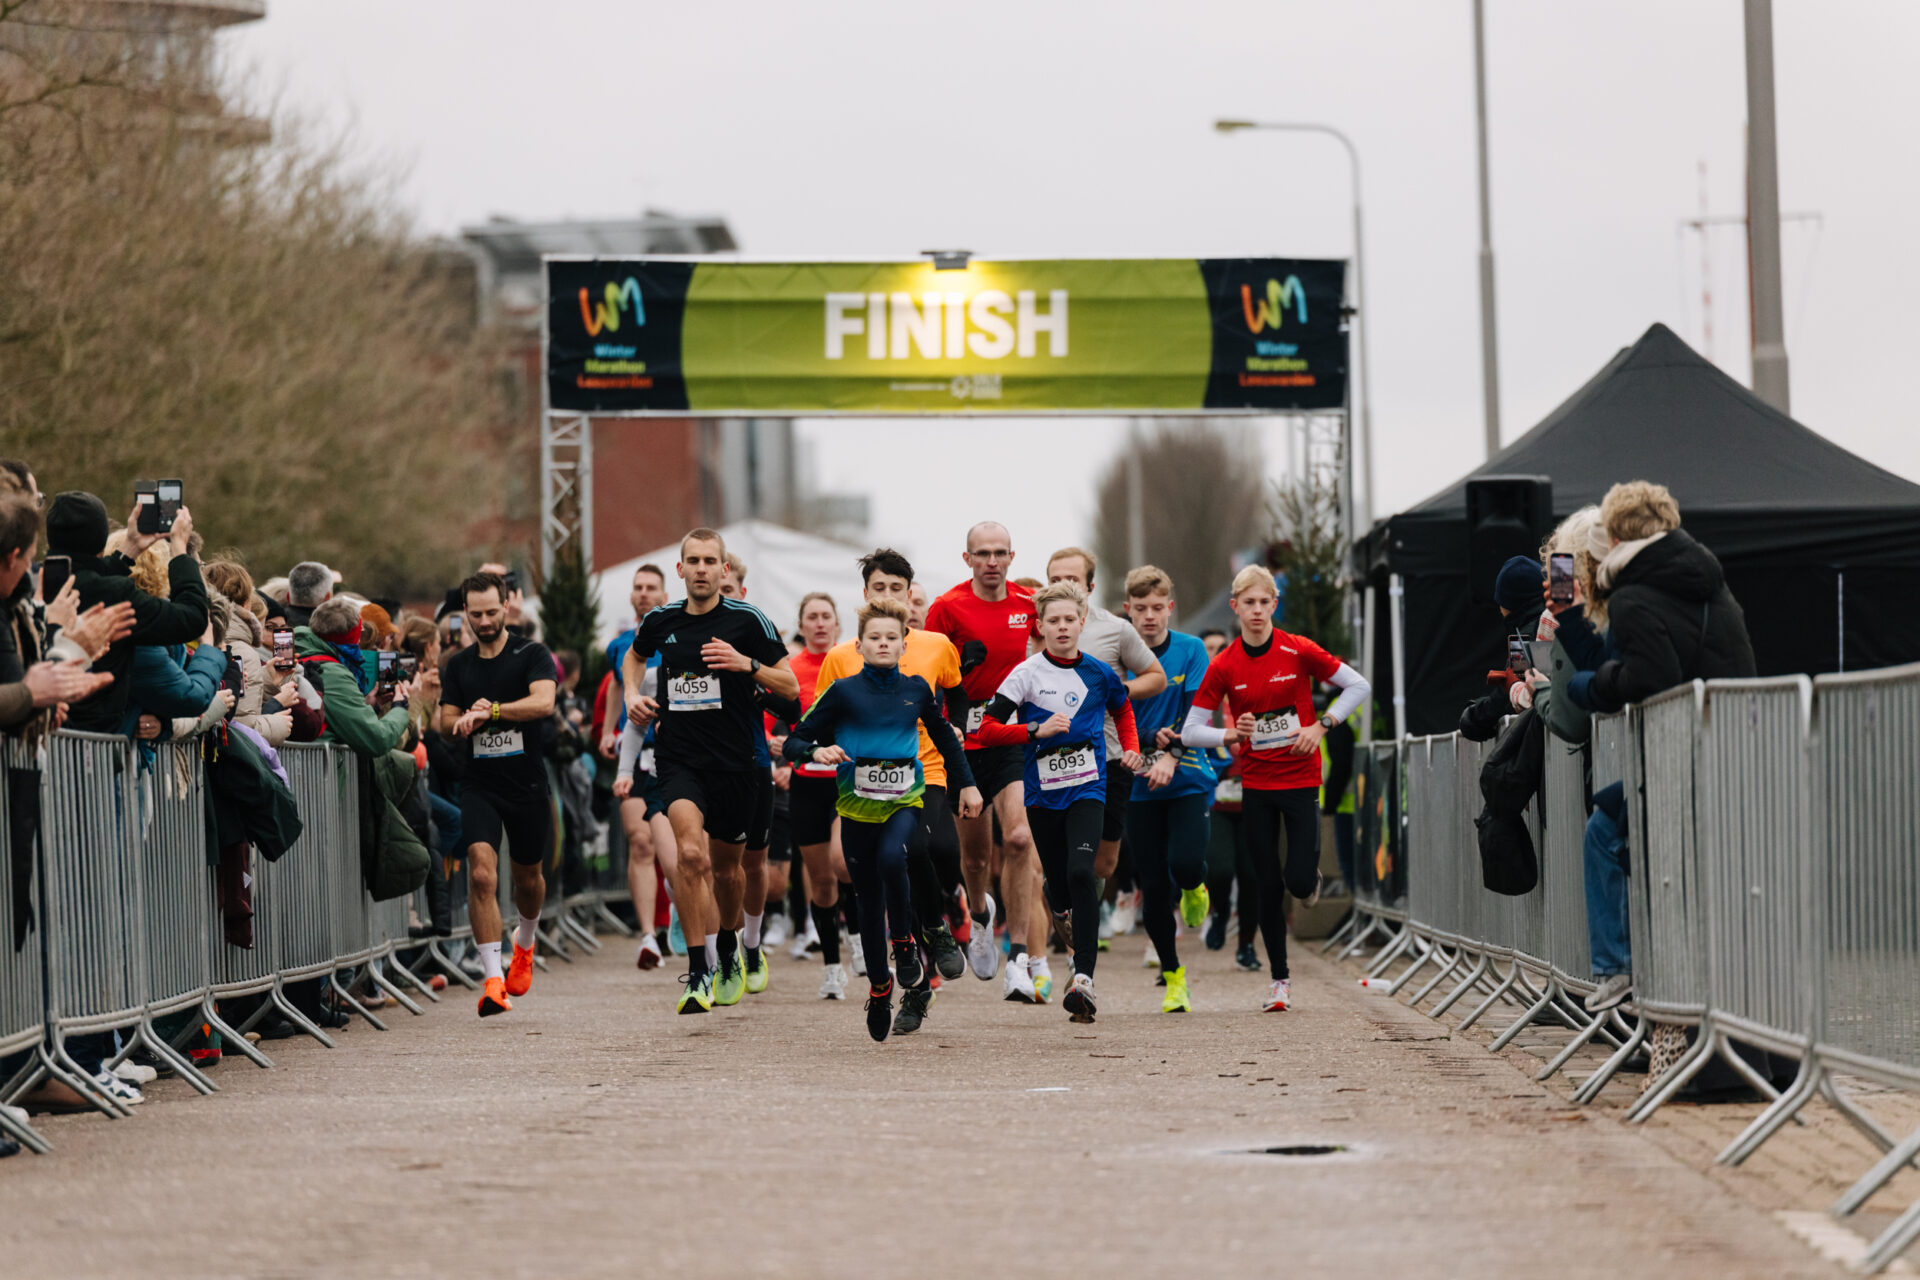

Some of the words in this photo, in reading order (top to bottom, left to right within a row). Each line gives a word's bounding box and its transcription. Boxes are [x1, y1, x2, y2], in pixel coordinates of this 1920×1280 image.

[825, 289, 1068, 360] FINISH
[593, 344, 636, 358] Winter
[1255, 341, 1298, 355] Winter
[584, 359, 645, 374] Marathon
[1246, 356, 1307, 371] Marathon
[674, 680, 708, 694] 4059
[1257, 719, 1289, 734] 4338
[480, 735, 512, 748] 4204
[1049, 754, 1086, 771] 6093
[868, 770, 904, 783] 6001
